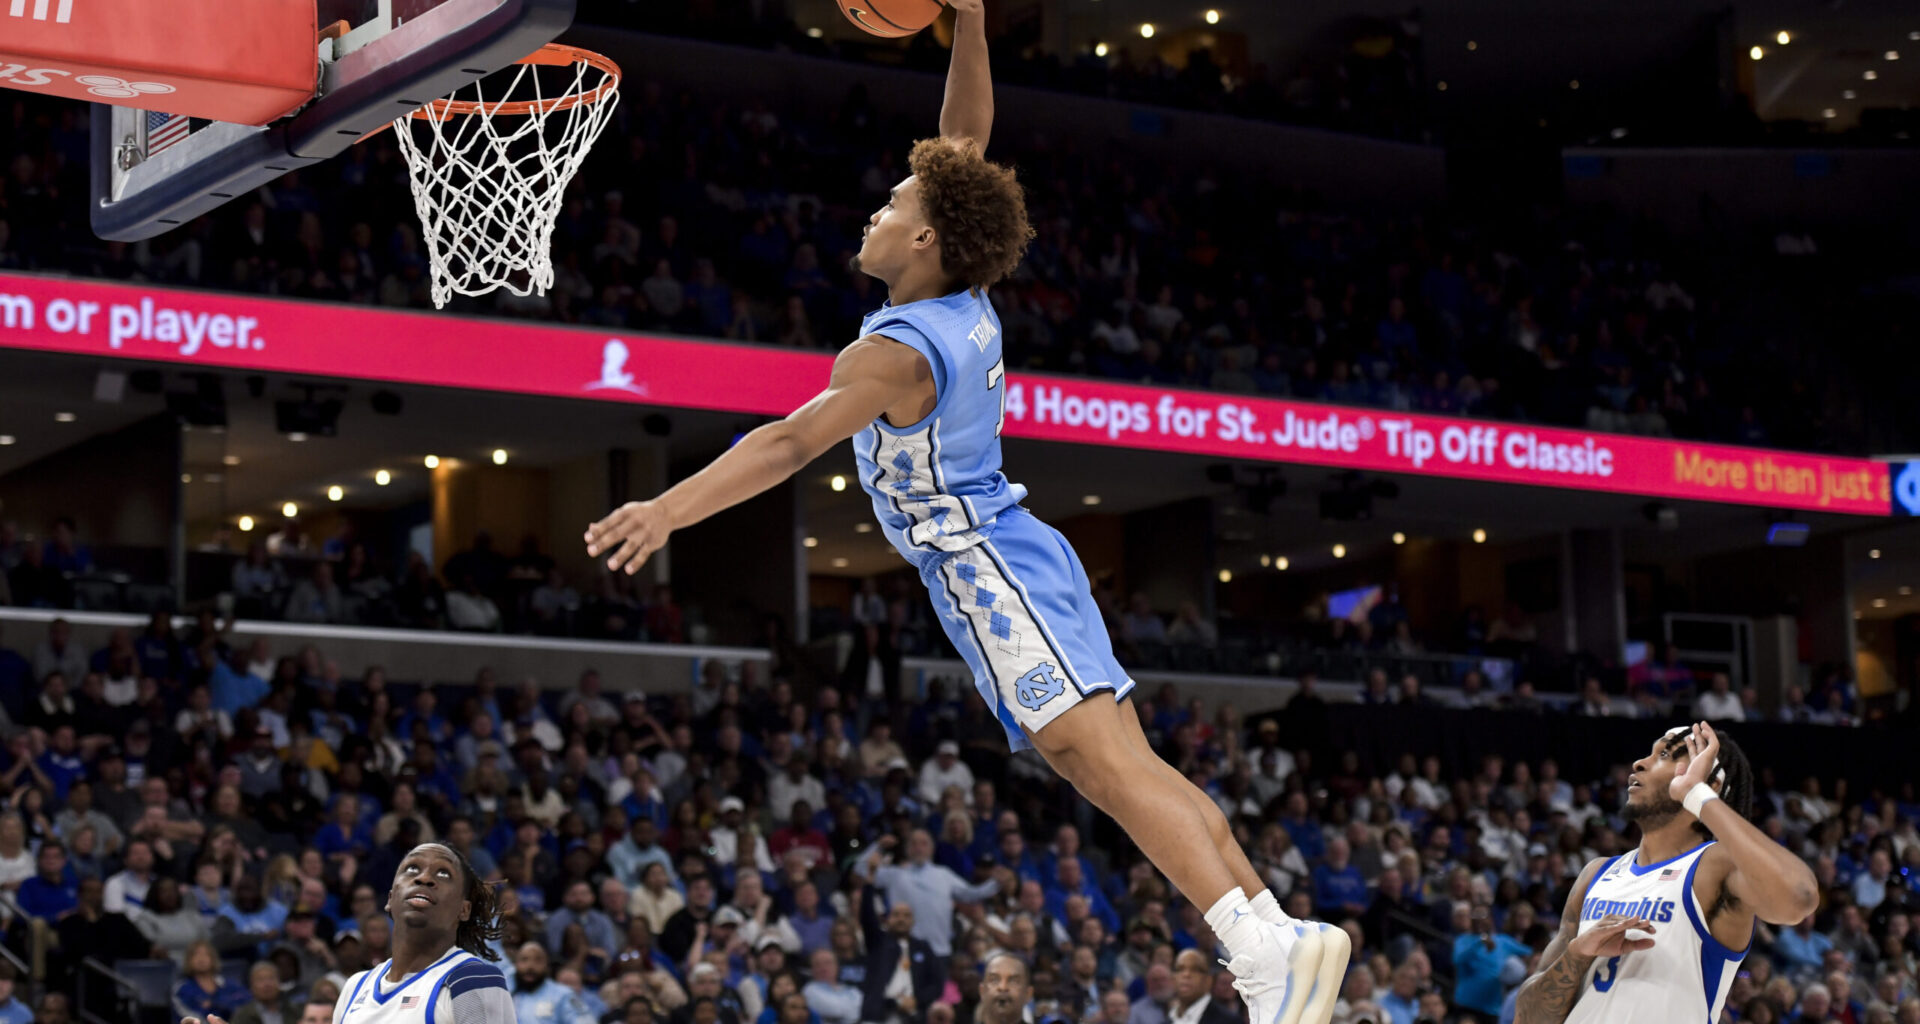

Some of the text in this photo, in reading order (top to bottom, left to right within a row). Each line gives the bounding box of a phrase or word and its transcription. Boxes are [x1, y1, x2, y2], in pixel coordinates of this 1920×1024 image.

[46, 298, 99, 334] or
[109, 297, 265, 355] player.
[987, 356, 1006, 439] 7
[1034, 386, 1151, 439] Hoops
[1156, 395, 1211, 437] for
[1217, 403, 1266, 443] St.
[1379, 419, 1435, 467] Tip
[1440, 426, 1498, 465] Off
[1503, 432, 1613, 476] Classic
[1674, 450, 1748, 489] More
[1753, 459, 1817, 495] than
[1819, 463, 1874, 506] just
[1581, 897, 1675, 923] Memphis
